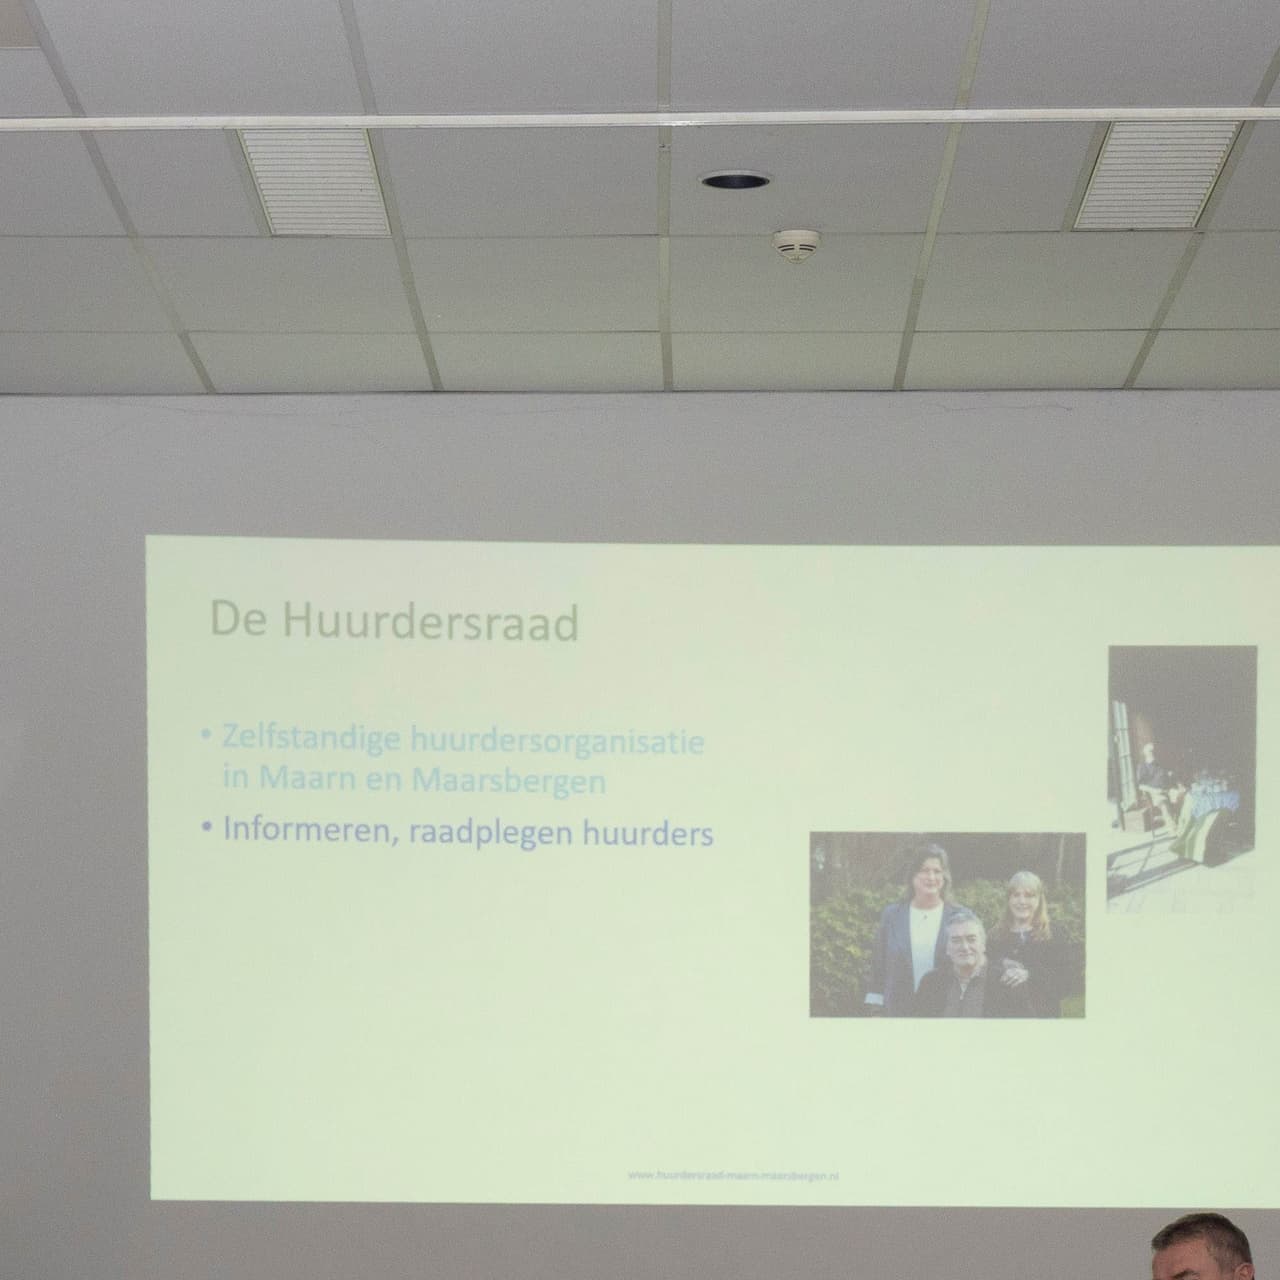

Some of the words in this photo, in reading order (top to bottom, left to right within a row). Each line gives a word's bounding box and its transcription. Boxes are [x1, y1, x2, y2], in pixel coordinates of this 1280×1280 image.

[211, 599, 267, 637] De
[283, 601, 580, 643] Huurdersraad
[222, 721, 401, 757] Zelfstandige
[412, 724, 705, 760] huurdersorganisatie
[223, 764, 249, 789] in
[260, 764, 356, 791] Maarn
[367, 771, 403, 792] en
[413, 766, 606, 800] Maarsbergen
[224, 814, 400, 848] Informeren,
[410, 817, 573, 852] raadplegen
[583, 817, 715, 848] huurders
